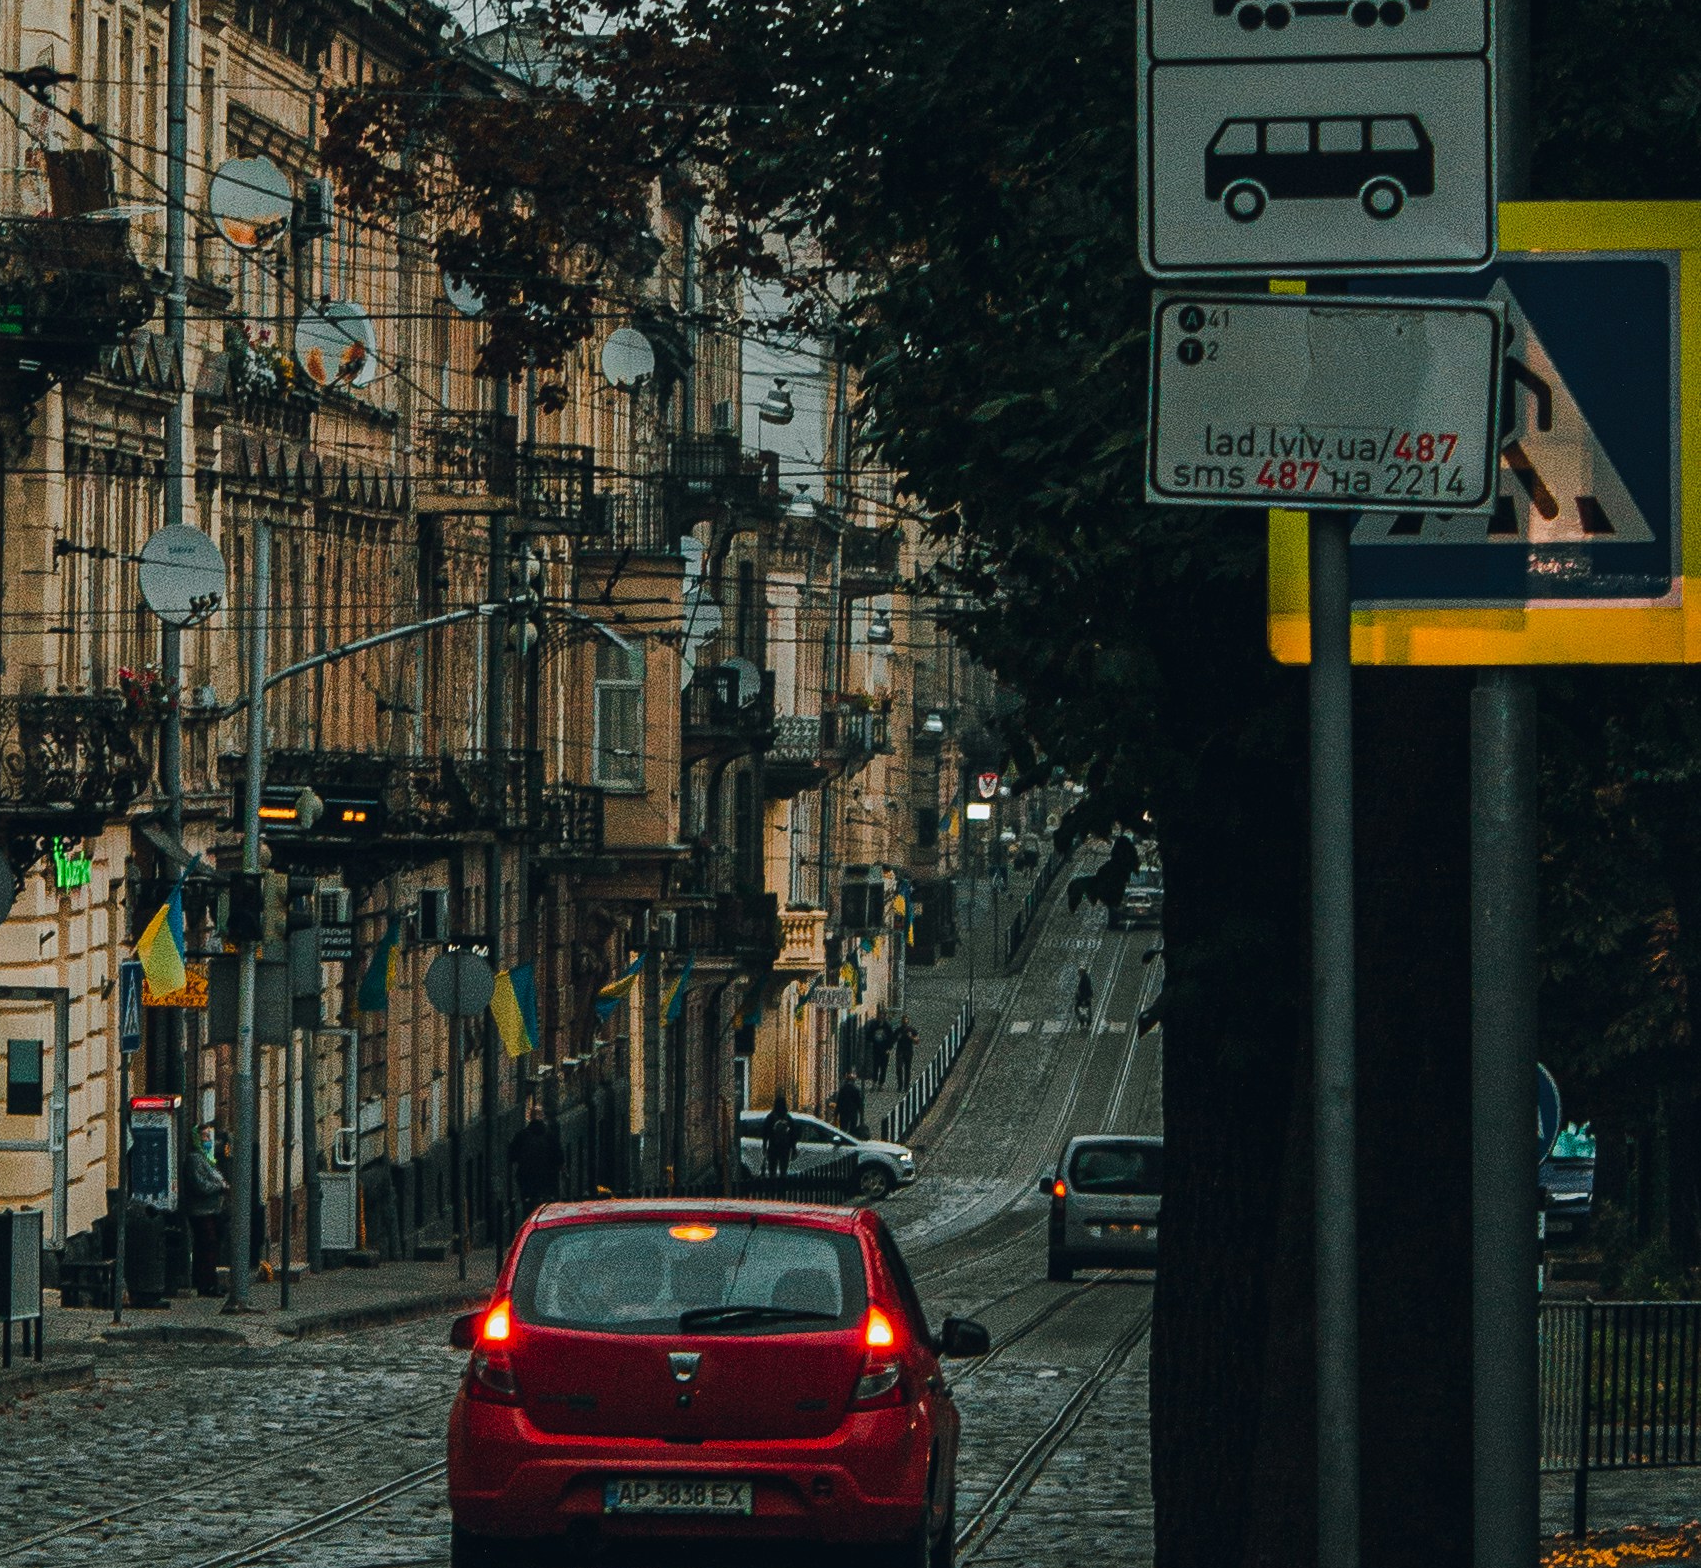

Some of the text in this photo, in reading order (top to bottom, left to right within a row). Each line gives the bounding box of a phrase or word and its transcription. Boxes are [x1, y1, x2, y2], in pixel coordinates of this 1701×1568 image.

[1208, 308, 1231, 329] 41
[1207, 340, 1220, 362] 2
[1204, 425, 1459, 463] lad.lviv.ua/487
[1174, 459, 1466, 496] sms 487 на 2214
[619, 1483, 649, 1505] AP
[711, 1483, 744, 1506] EX
